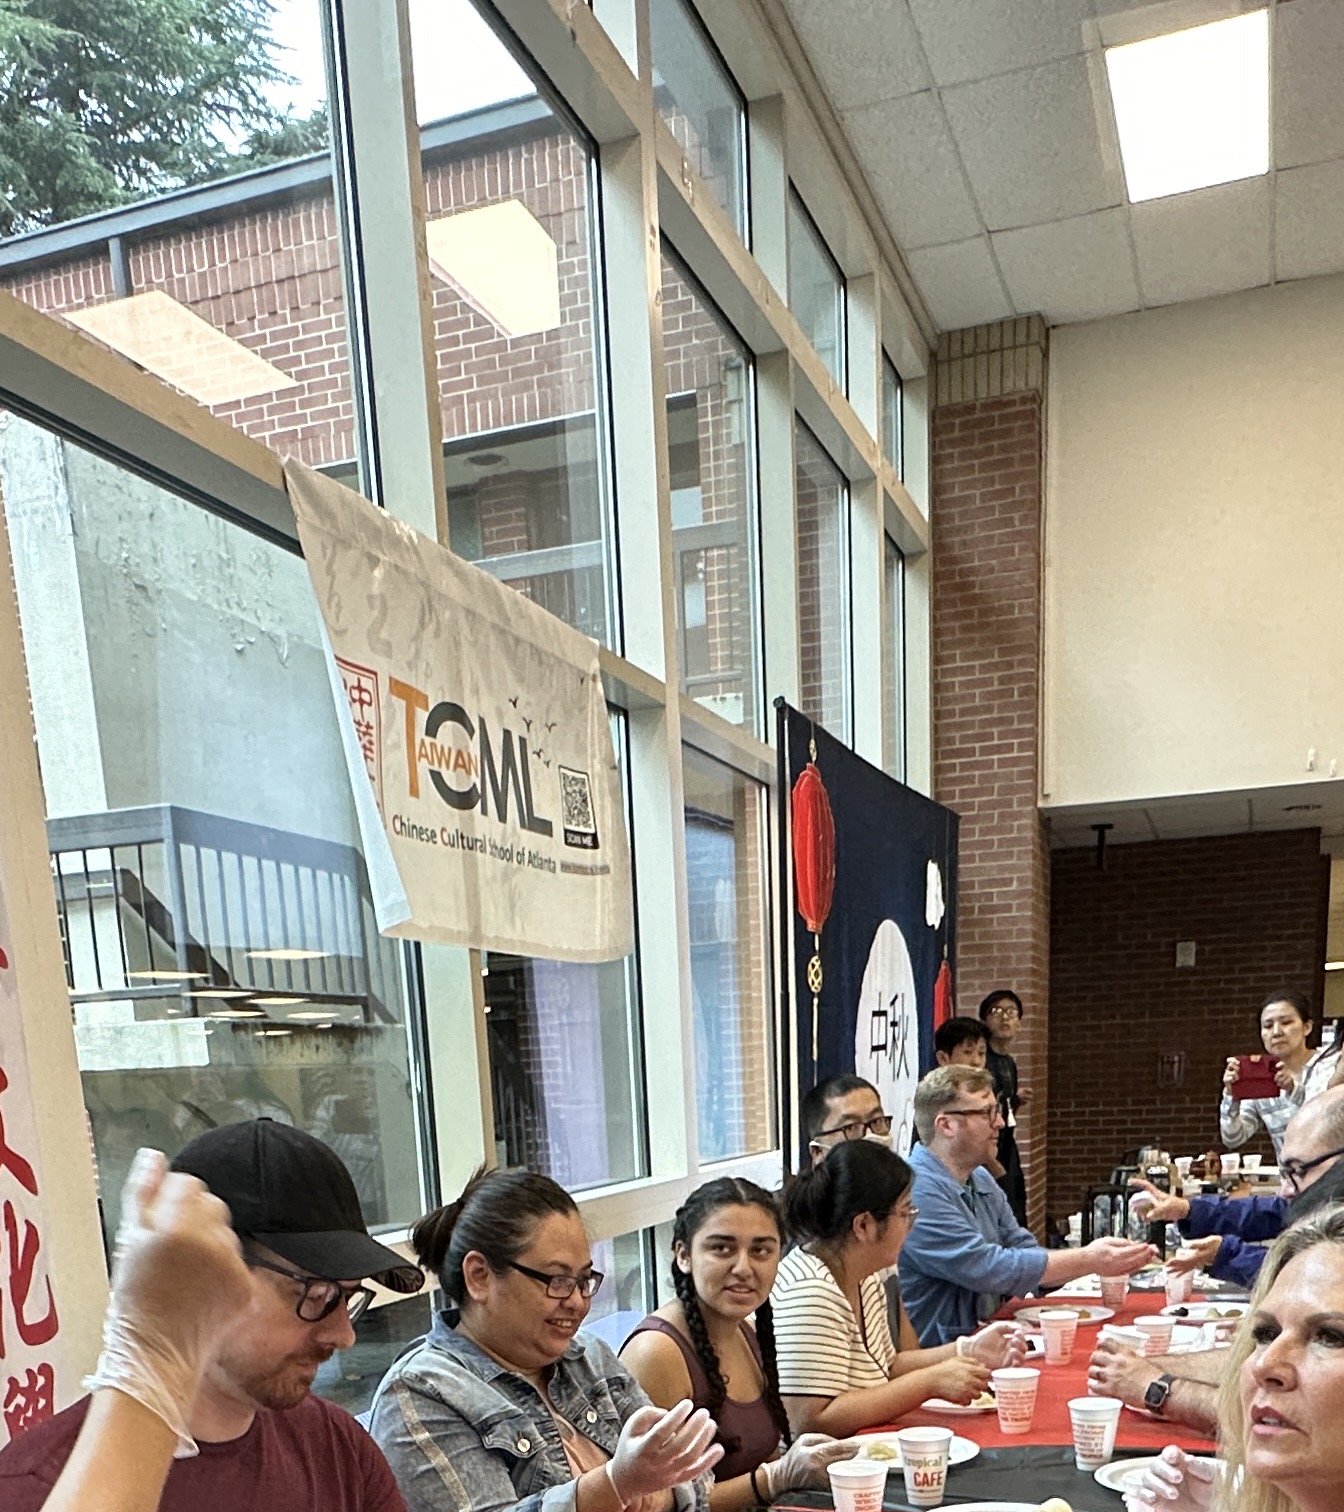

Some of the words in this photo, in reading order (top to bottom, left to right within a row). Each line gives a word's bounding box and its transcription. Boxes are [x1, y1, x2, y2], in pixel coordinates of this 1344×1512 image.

[392, 814, 438, 845] Chinese
[440, 827, 487, 854] Cultural
[489, 838, 514, 862] School
[516, 847, 526, 866] of
[527, 850, 556, 874] Atlanta
[904, 1455, 943, 1469] tropical
[913, 1471, 944, 1487] CAFE
